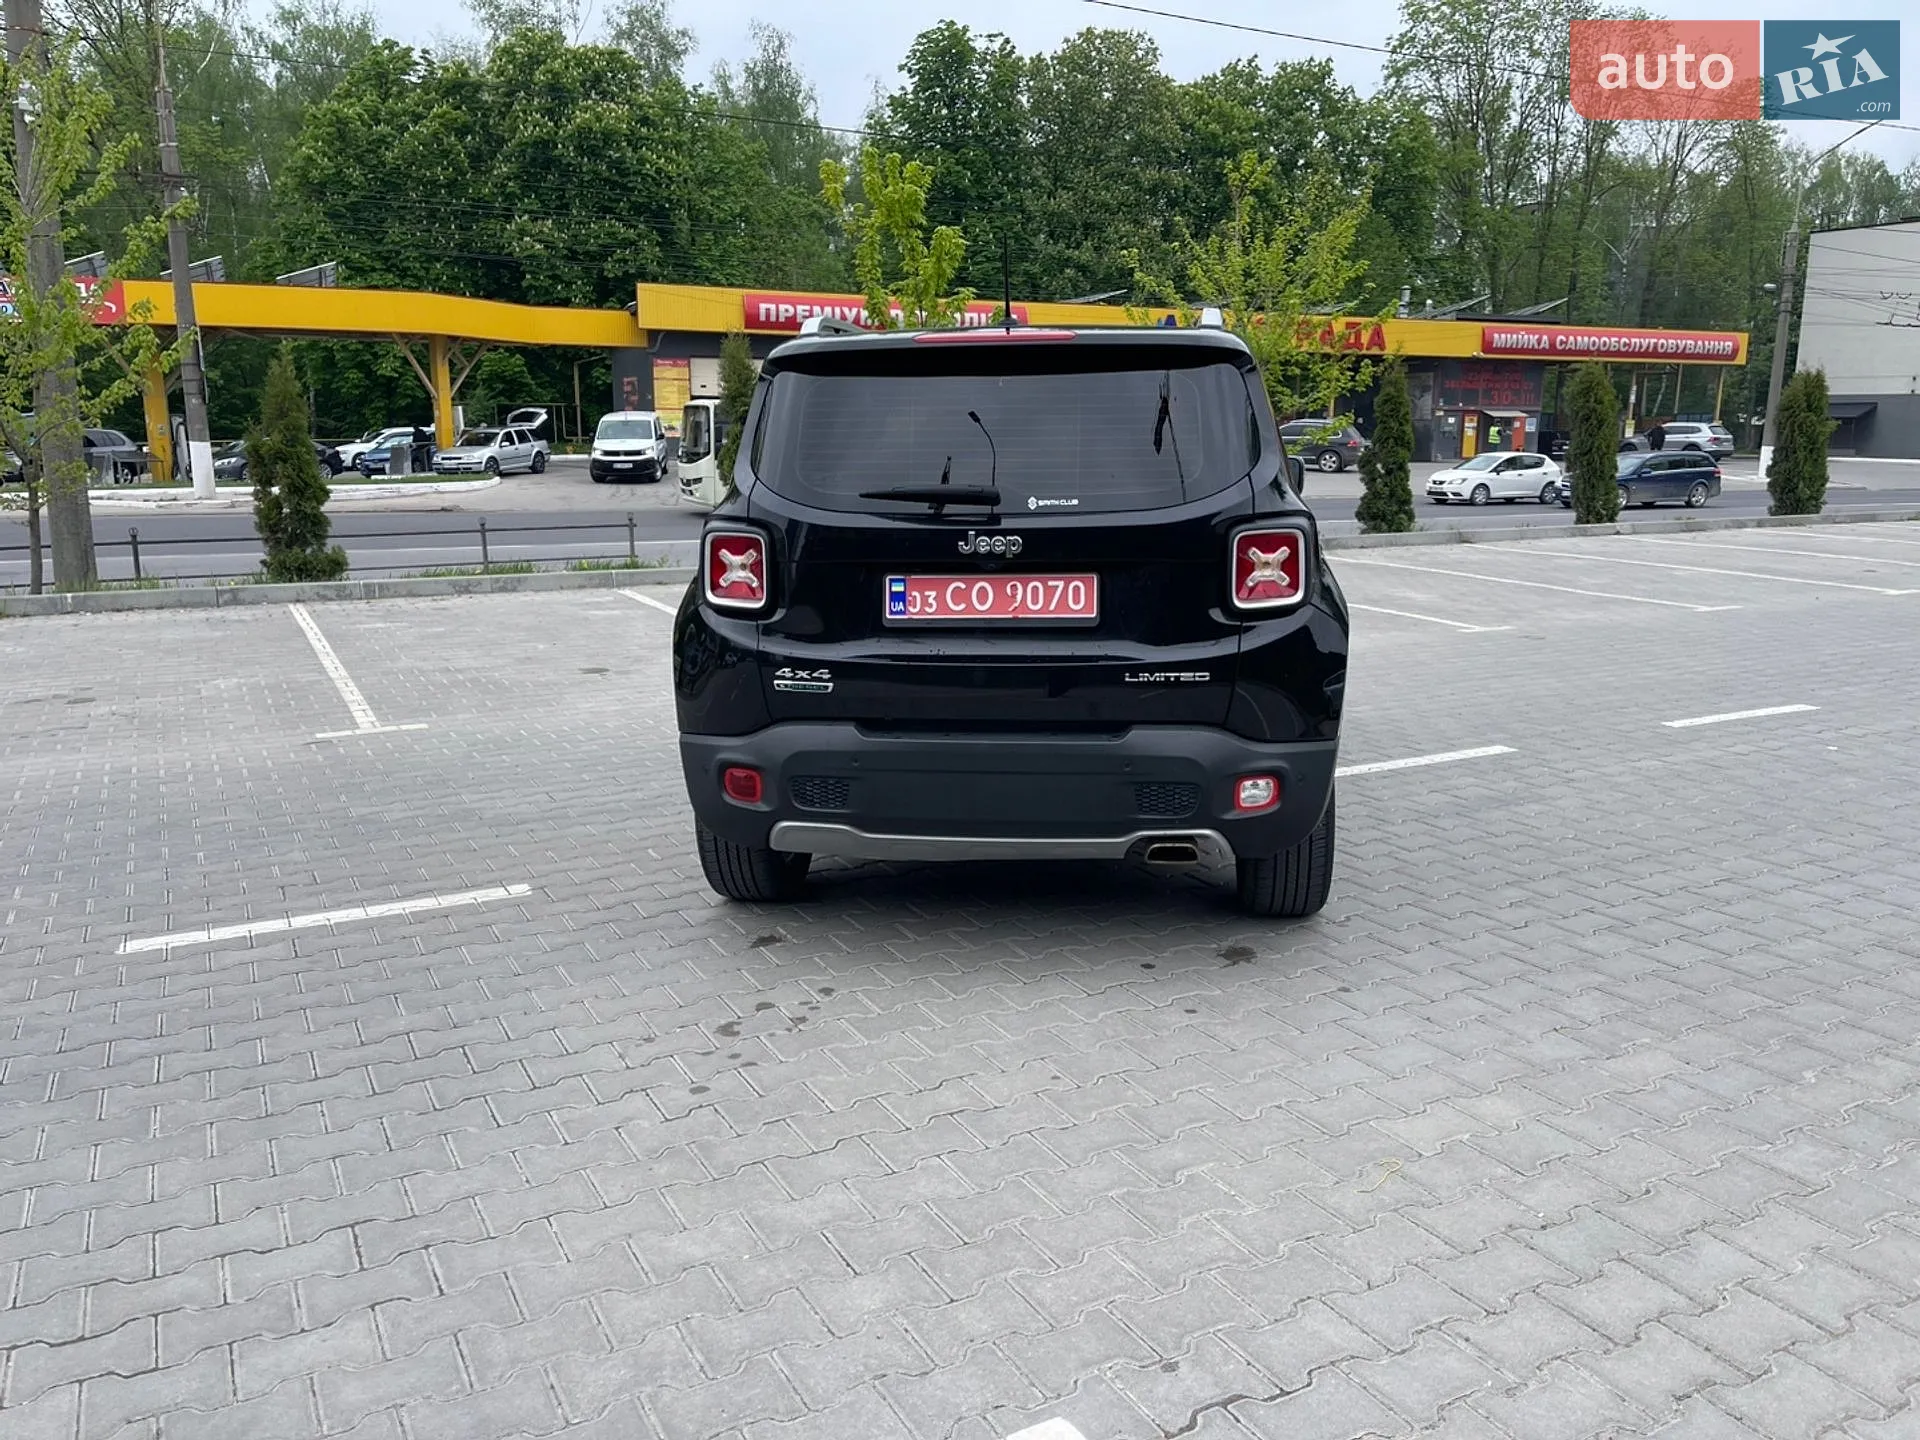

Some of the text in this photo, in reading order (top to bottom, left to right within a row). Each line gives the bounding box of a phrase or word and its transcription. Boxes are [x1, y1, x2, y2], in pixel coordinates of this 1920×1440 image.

[1492, 330, 1733, 356] МИЙКА САМООБСЛУГОВУВАННЯ
[958, 531, 1023, 558] Jeep
[890, 580, 1086, 613] UA 03 CO 9070
[774, 667, 832, 680] 4x4
[1124, 671, 1210, 681] LIMITED
